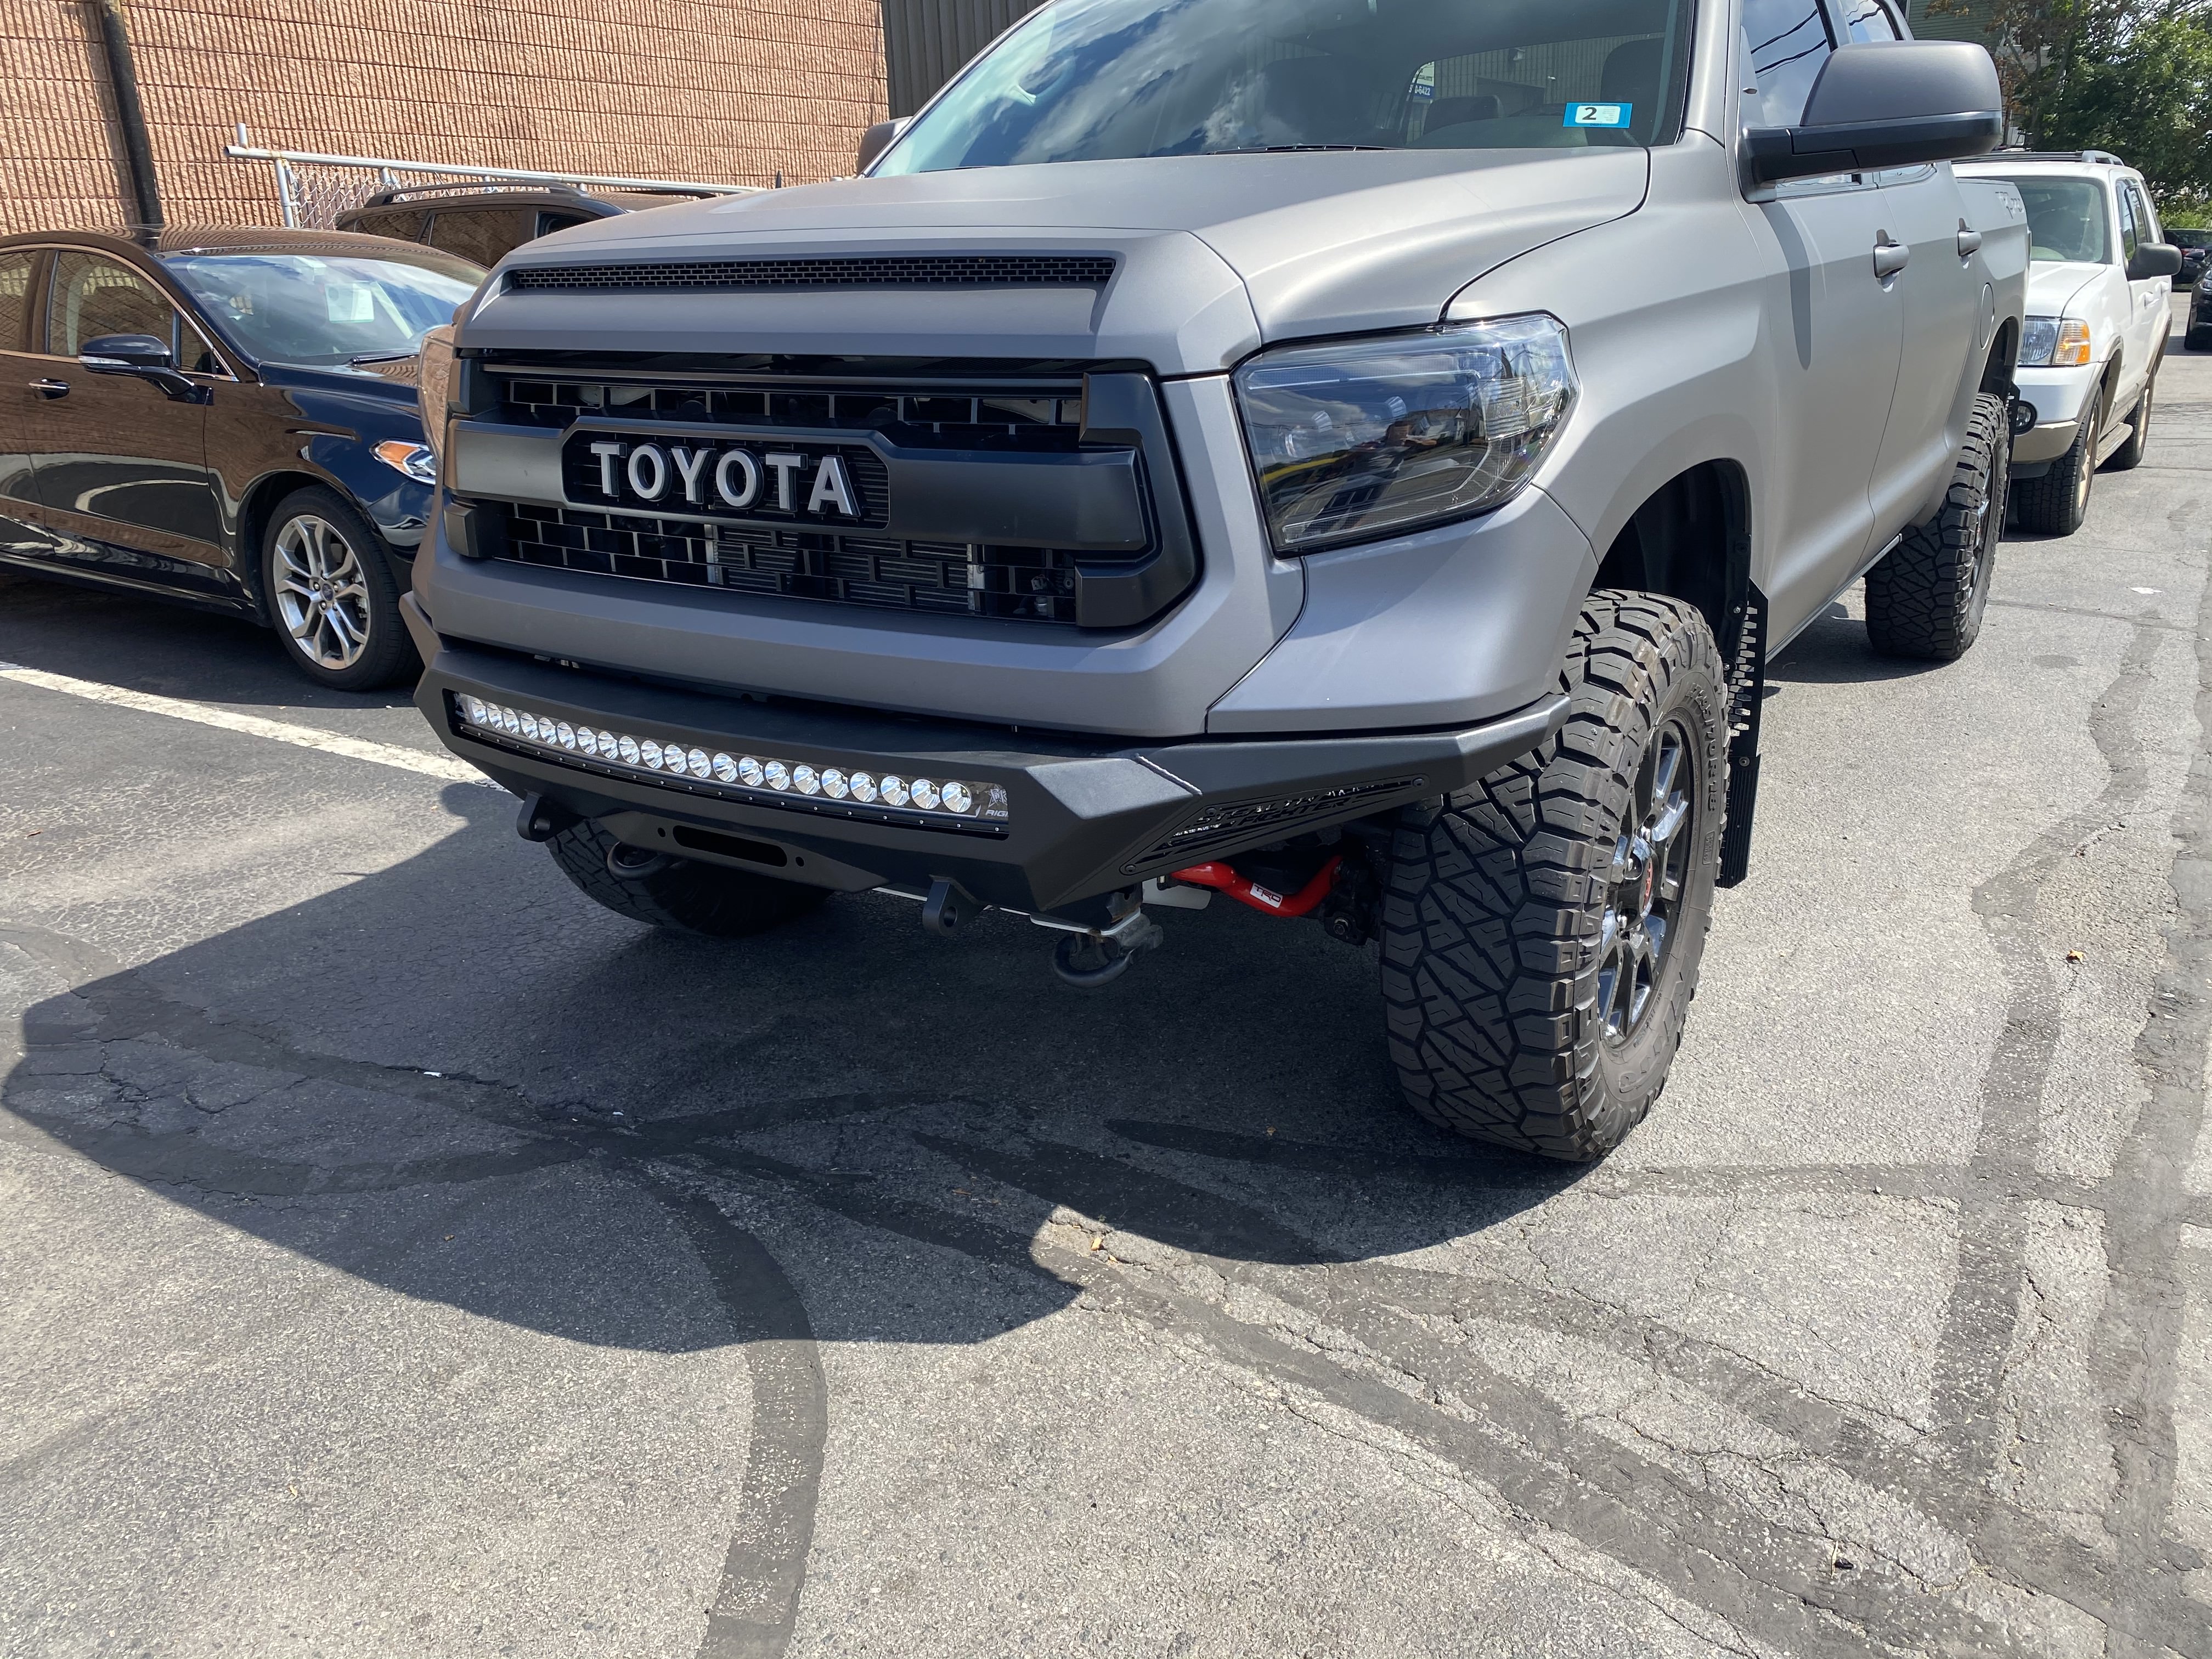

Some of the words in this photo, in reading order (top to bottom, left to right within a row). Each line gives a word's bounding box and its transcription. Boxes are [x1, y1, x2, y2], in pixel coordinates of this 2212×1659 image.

[1582, 106, 1597, 120] 2
[590, 441, 860, 517] TOYOTA
[1254, 884, 1281, 903] TRD
